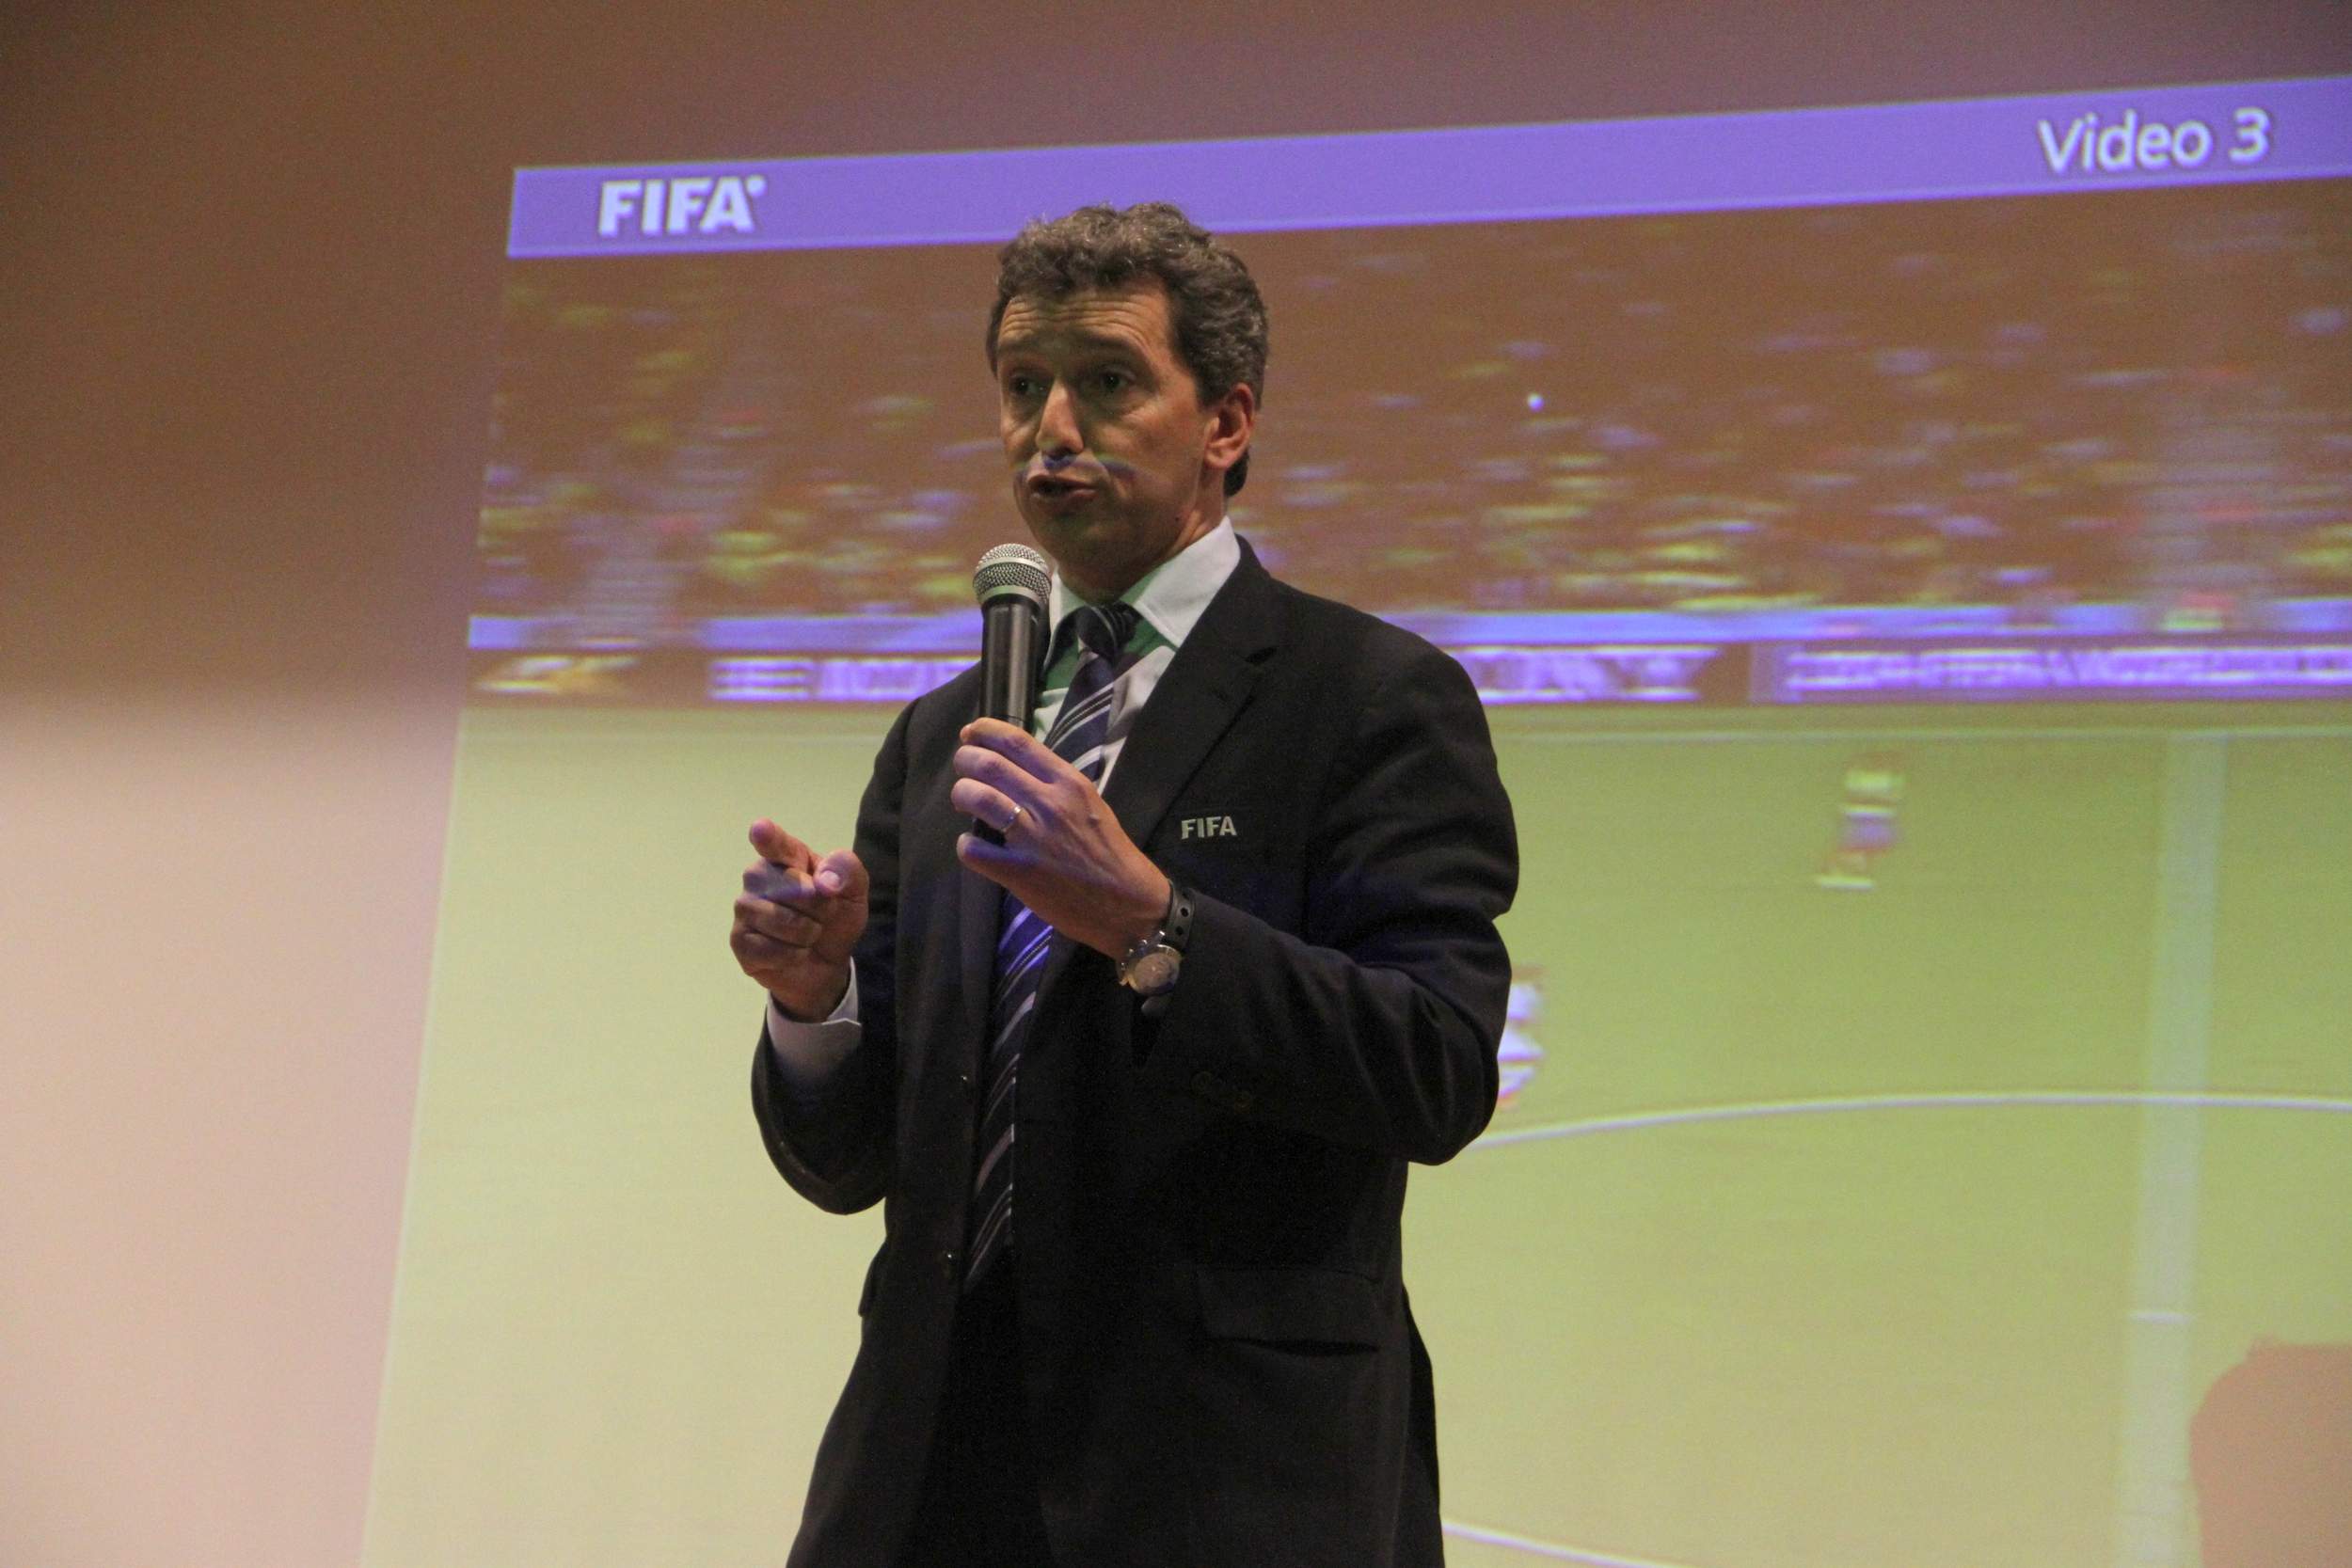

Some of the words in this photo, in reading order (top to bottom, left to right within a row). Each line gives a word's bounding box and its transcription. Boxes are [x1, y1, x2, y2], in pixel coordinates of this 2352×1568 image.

[2037, 108, 2211, 173] Video
[2229, 107, 2270, 164] 3
[598, 176, 758, 237] FIFA
[1181, 816, 1237, 840] FIFA
